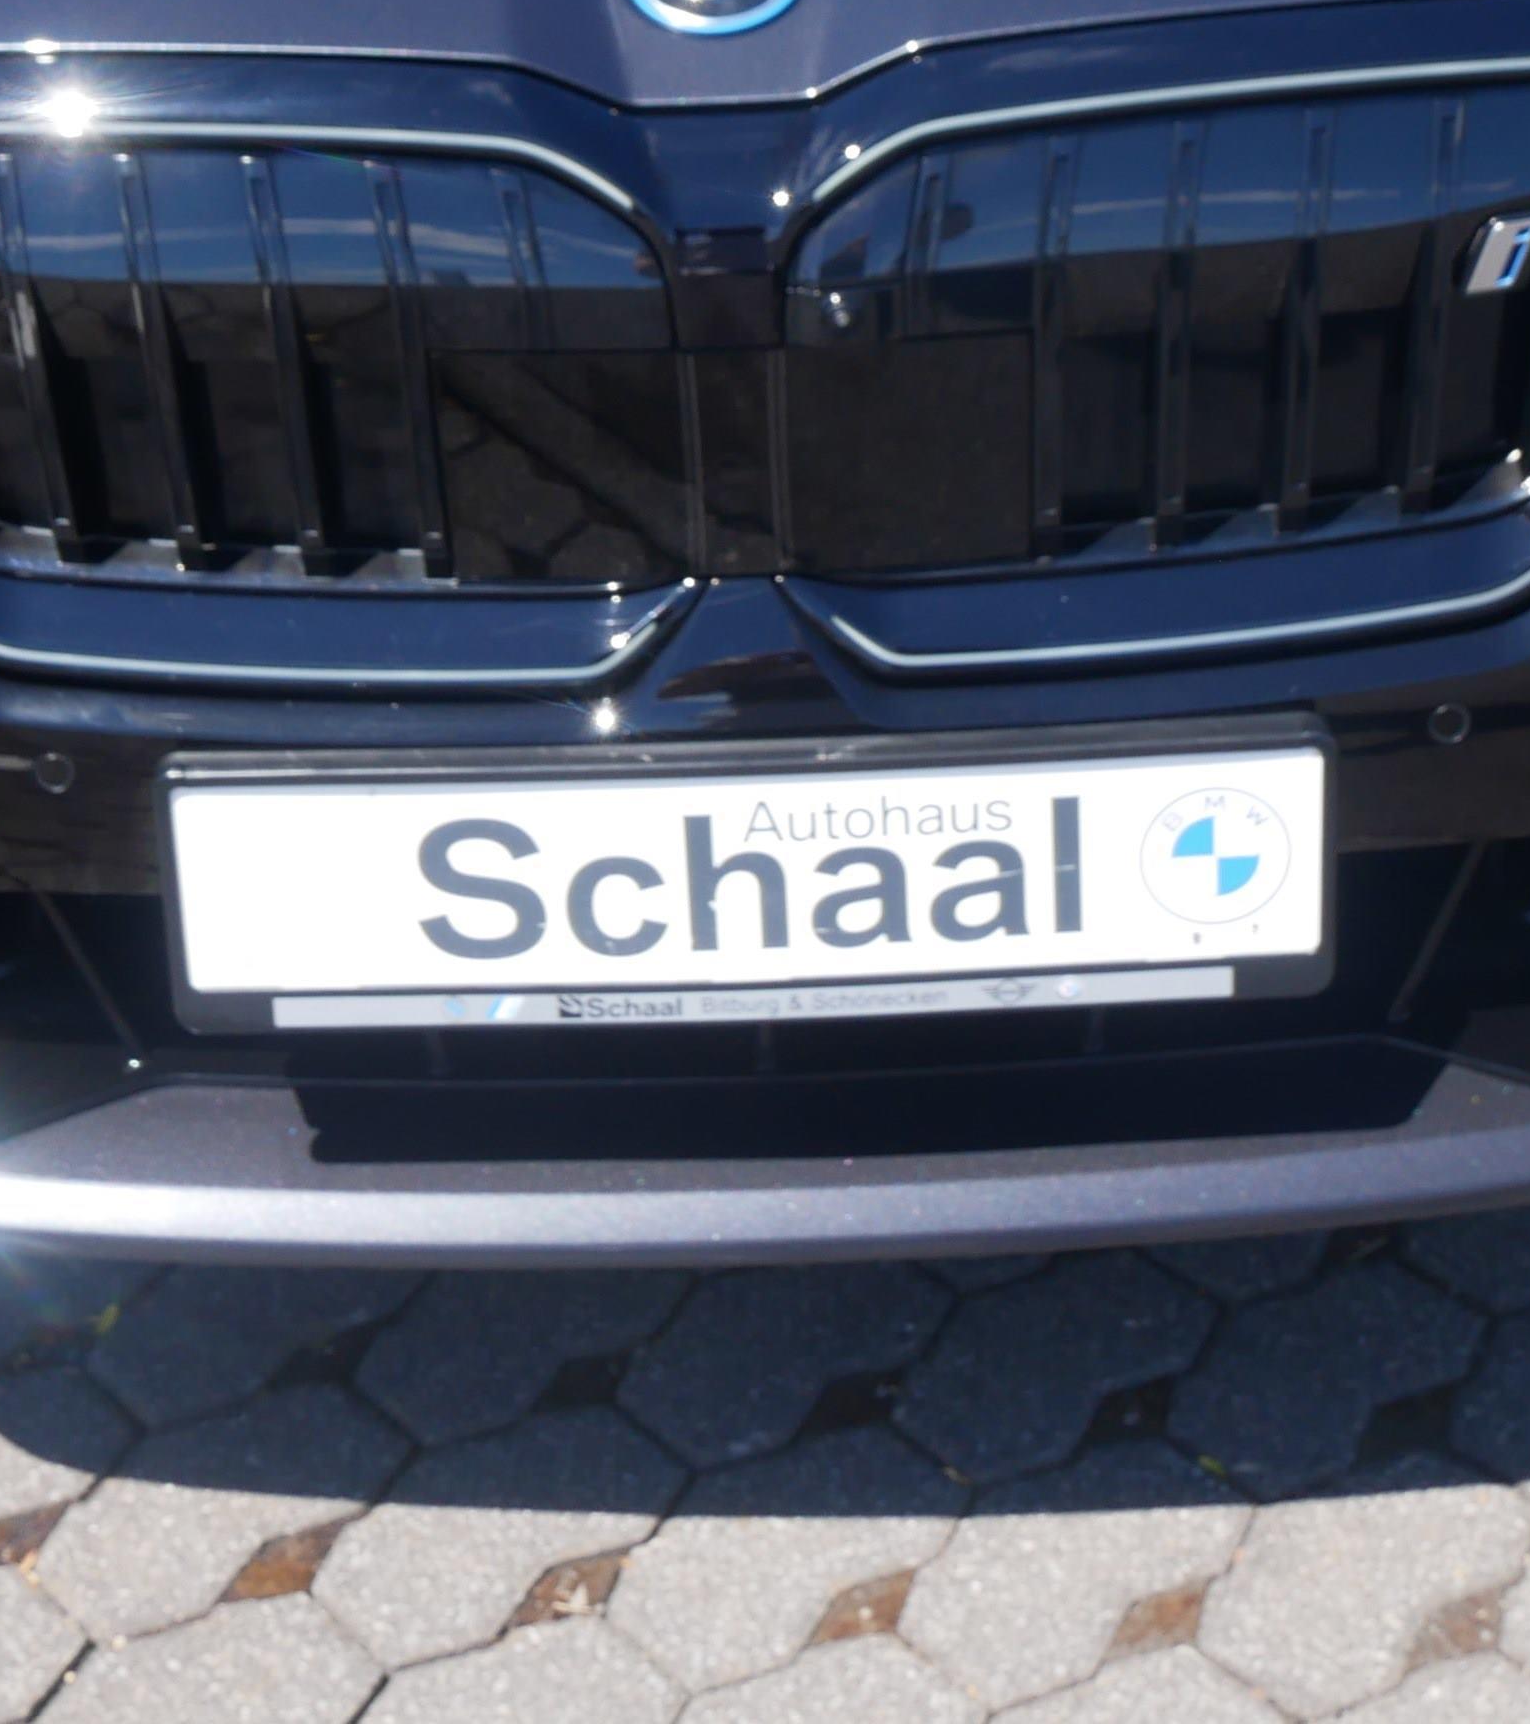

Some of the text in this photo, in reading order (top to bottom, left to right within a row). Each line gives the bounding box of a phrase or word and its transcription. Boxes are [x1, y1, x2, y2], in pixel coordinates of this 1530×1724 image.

[743, 796, 1013, 843] Autohaus
[417, 795, 1082, 960] Schaal
[587, 996, 683, 1017] Schaal
